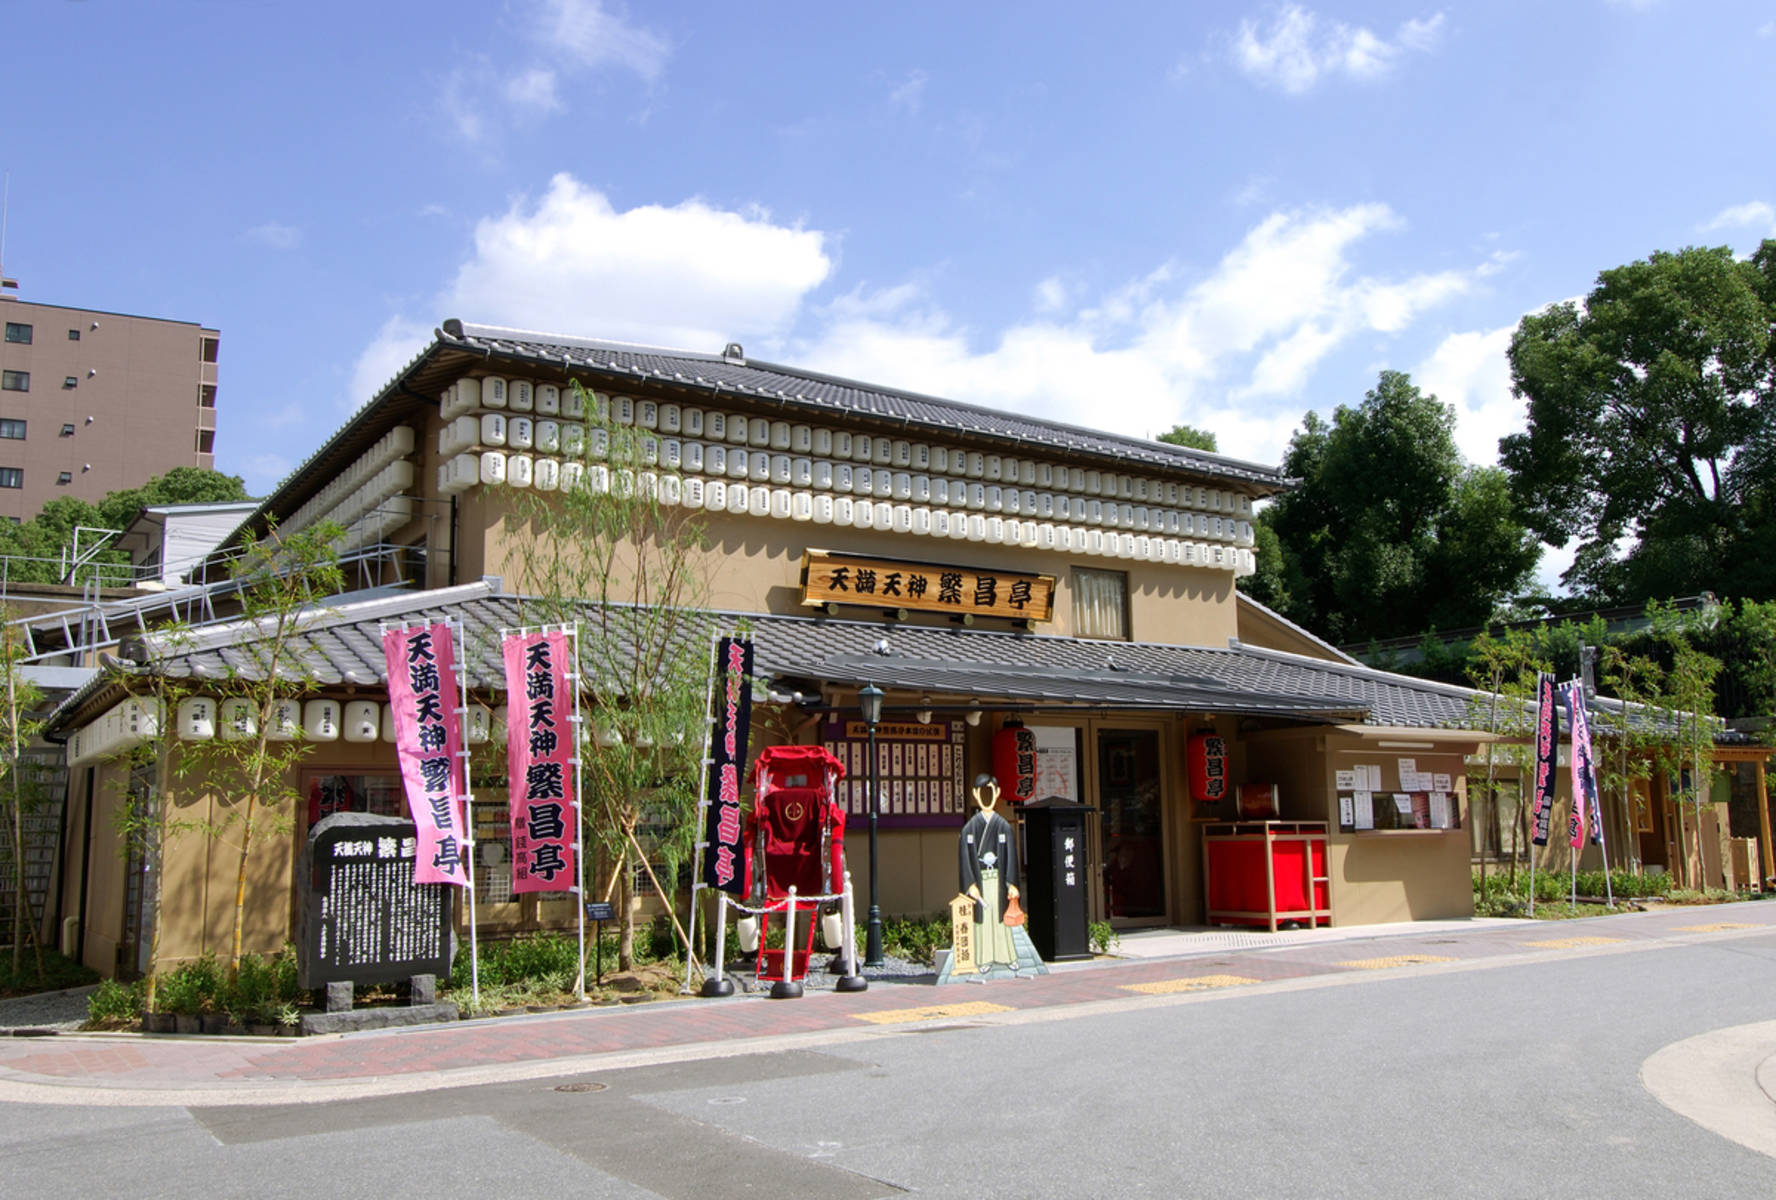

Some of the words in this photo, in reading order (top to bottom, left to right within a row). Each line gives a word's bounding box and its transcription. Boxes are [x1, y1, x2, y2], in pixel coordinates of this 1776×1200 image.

[829, 566, 1032, 610] 天満天神繁昌亭
[525, 641, 566, 881] 天満天神繁昌亭
[1016, 730, 1035, 797] 繁昌亭
[1204, 737, 1224, 798] 繁昌亭
